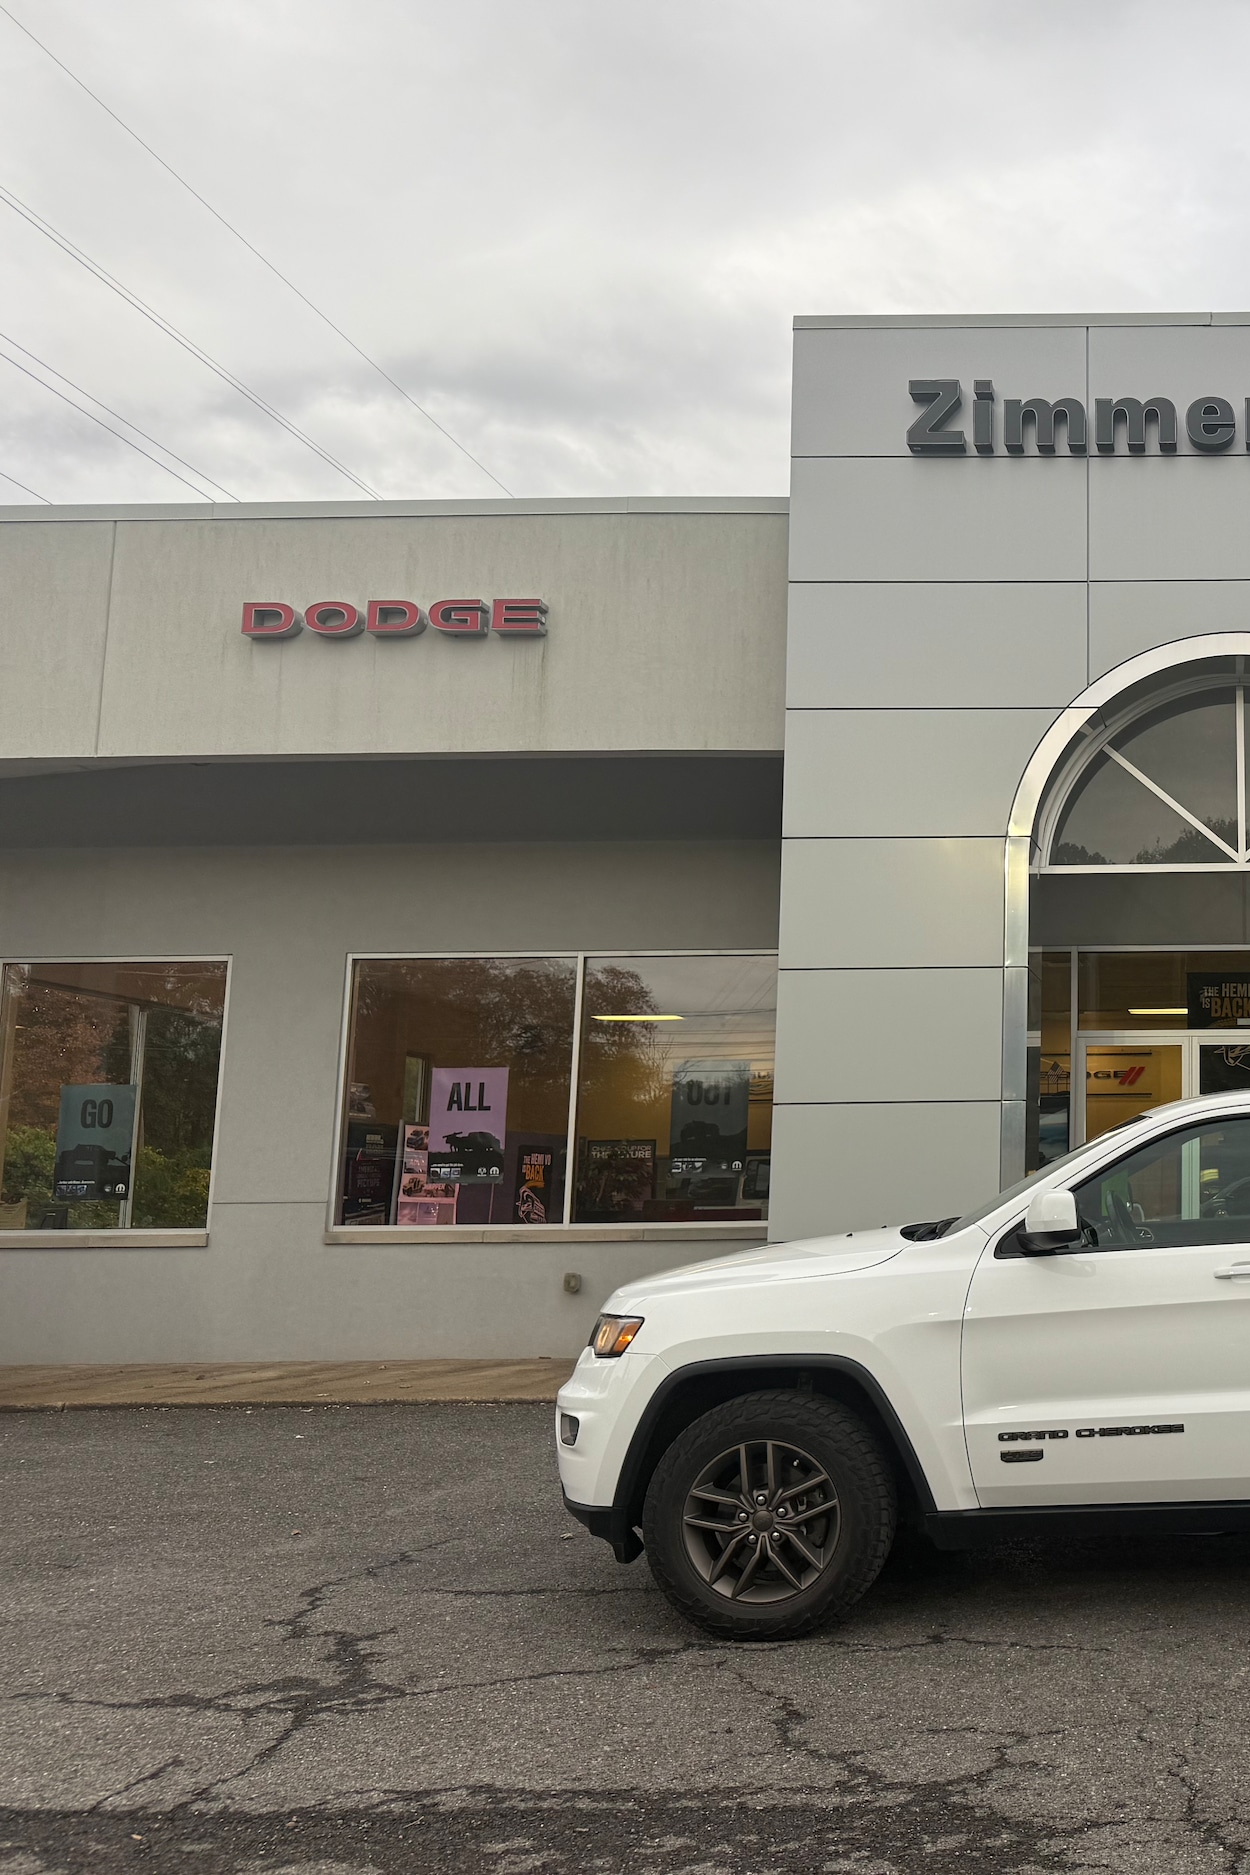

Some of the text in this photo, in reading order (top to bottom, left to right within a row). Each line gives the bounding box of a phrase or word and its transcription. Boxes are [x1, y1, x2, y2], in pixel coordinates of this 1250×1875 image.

[241, 598, 549, 638] DODGE
[1203, 986, 1219, 997] THE
[1202, 998, 1210, 1009] IS
[446, 1082, 491, 1111] ALL
[80, 1099, 114, 1128] GO
[525, 1164, 544, 1180] BACK
[997, 1423, 1185, 1442] GRAND CHEROKEE
